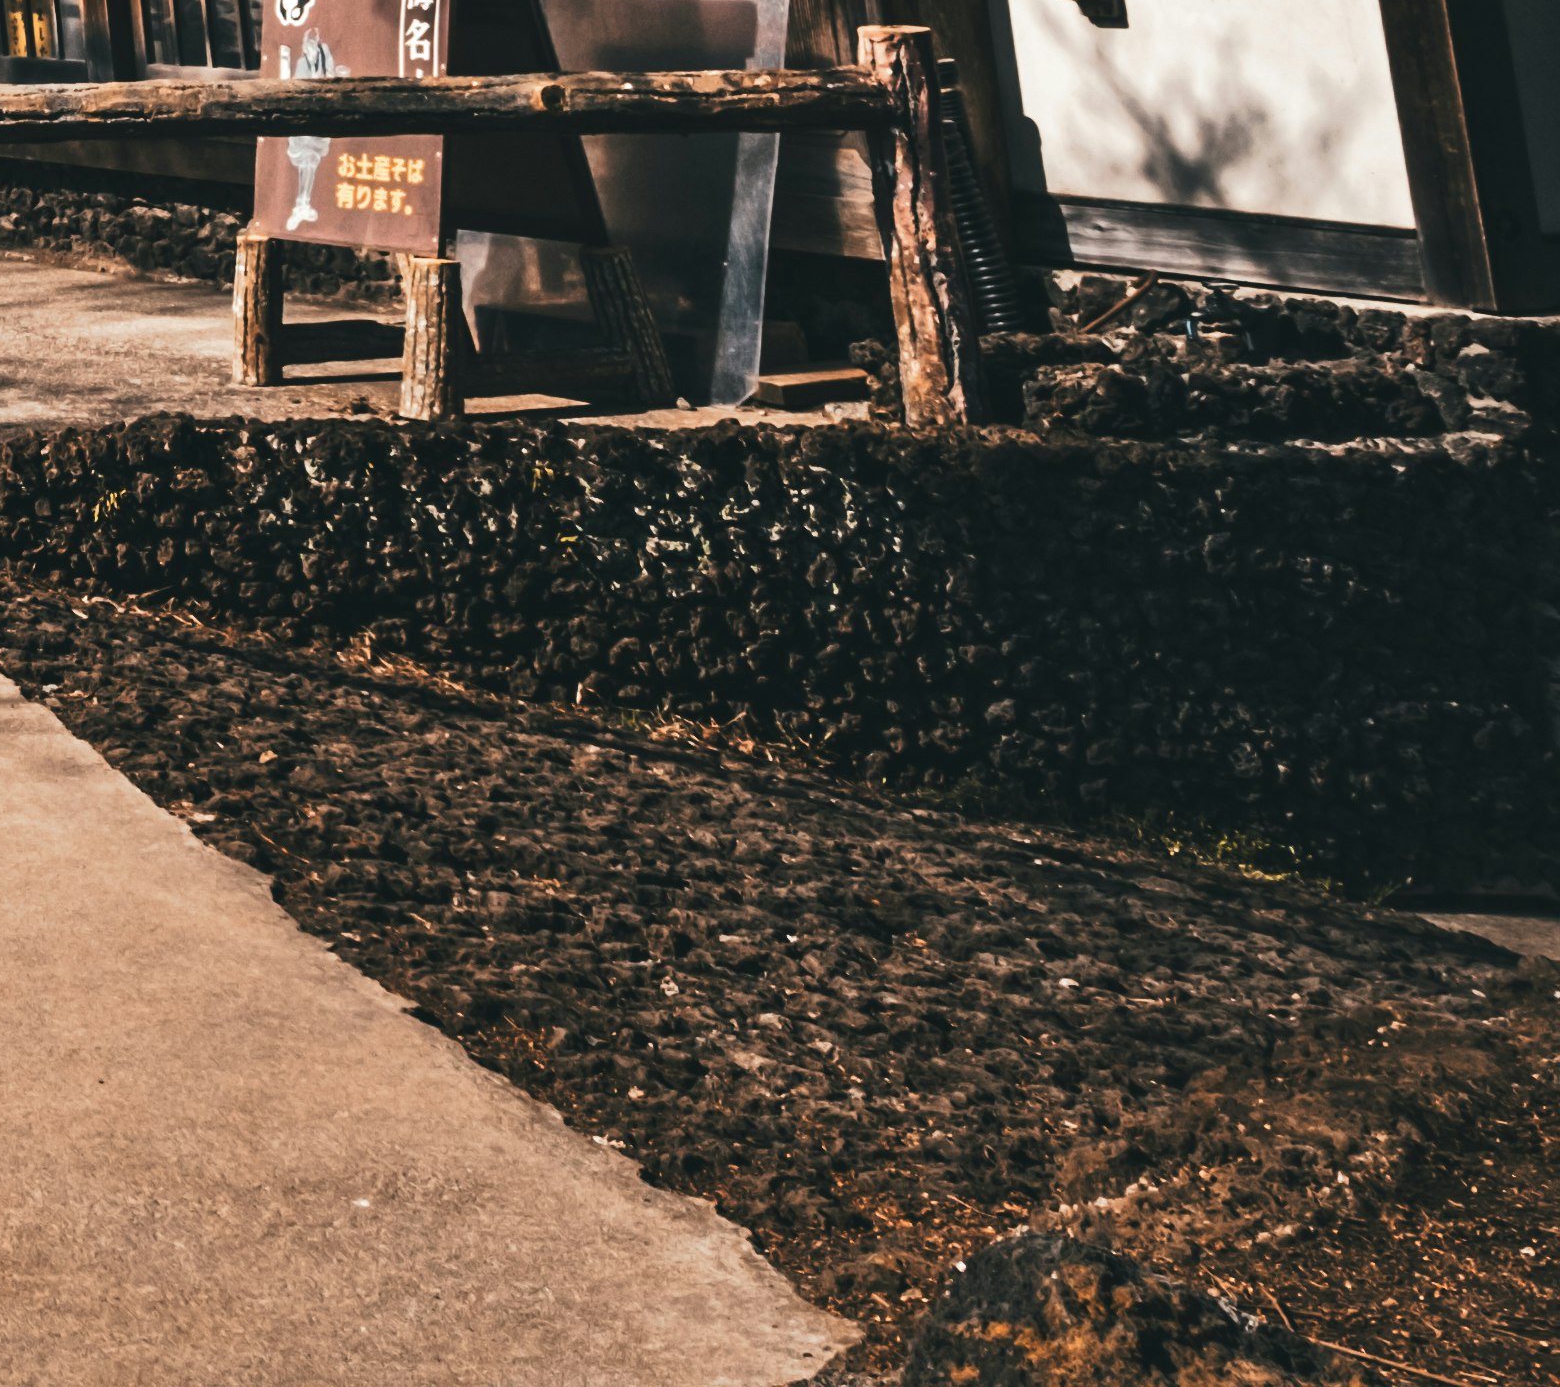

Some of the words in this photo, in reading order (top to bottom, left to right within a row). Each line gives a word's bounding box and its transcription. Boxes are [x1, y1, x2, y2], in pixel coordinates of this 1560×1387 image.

[337, 153, 425, 184] お土産そば
[336, 181, 413, 215] 有ります。
